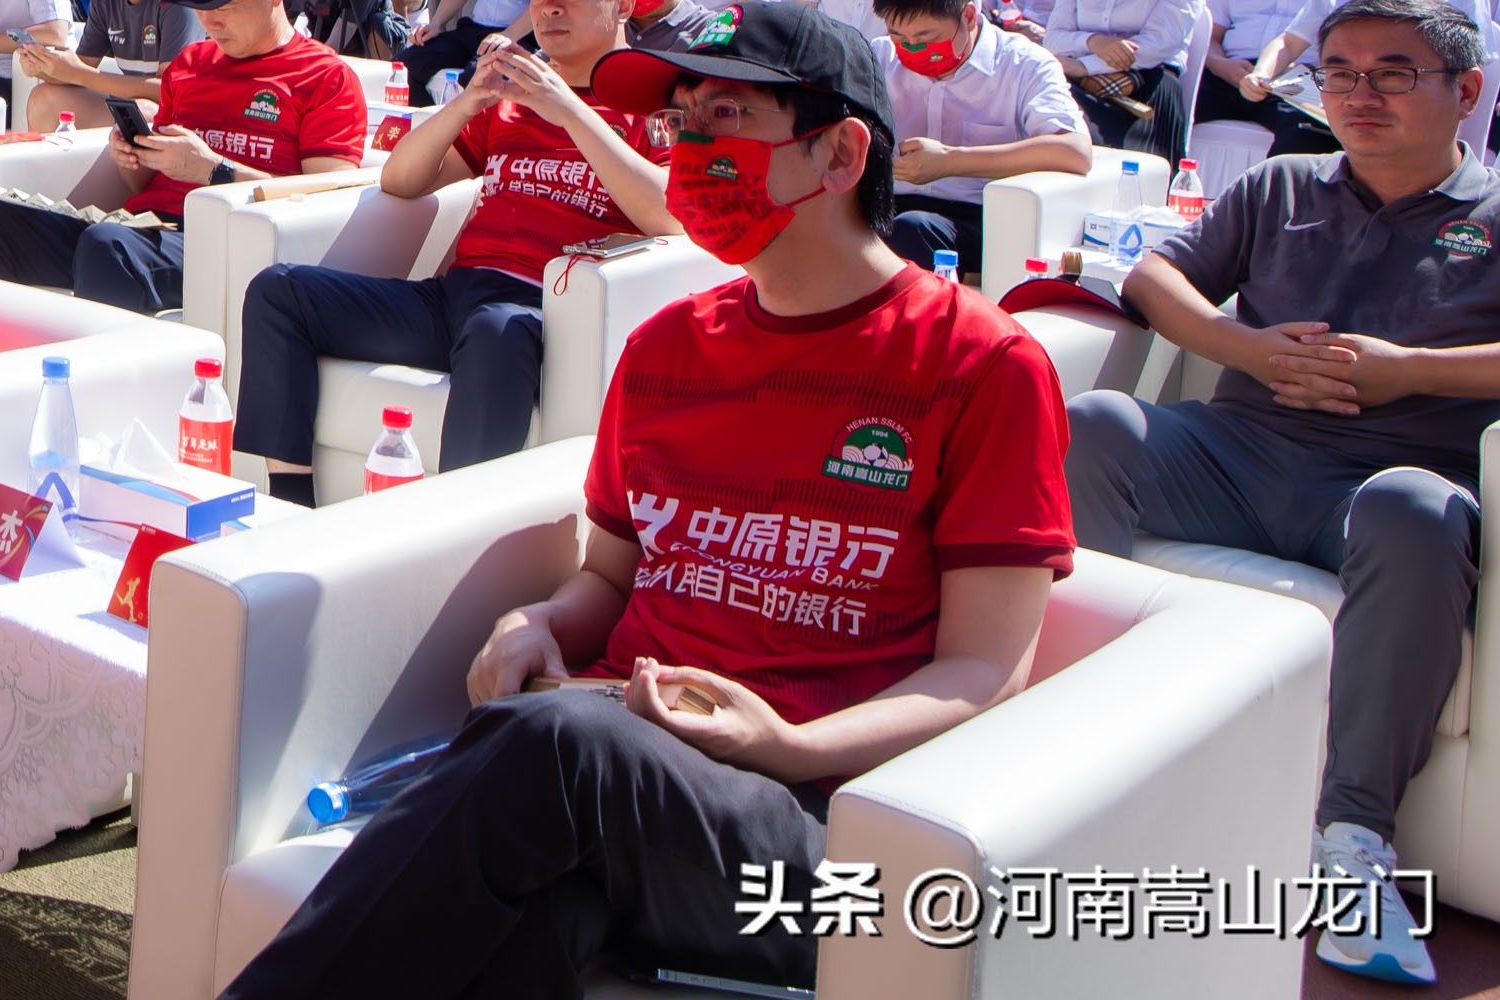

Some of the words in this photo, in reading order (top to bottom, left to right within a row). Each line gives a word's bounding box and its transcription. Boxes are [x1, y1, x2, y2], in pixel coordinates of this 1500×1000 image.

[845, 416, 879, 433] HENAN
[880, 417, 905, 434] SSLM
[826, 460, 909, 488] 河南嵩山龙门
[687, 506, 900, 580] 中原银行
[811, 567, 880, 592] BANK
